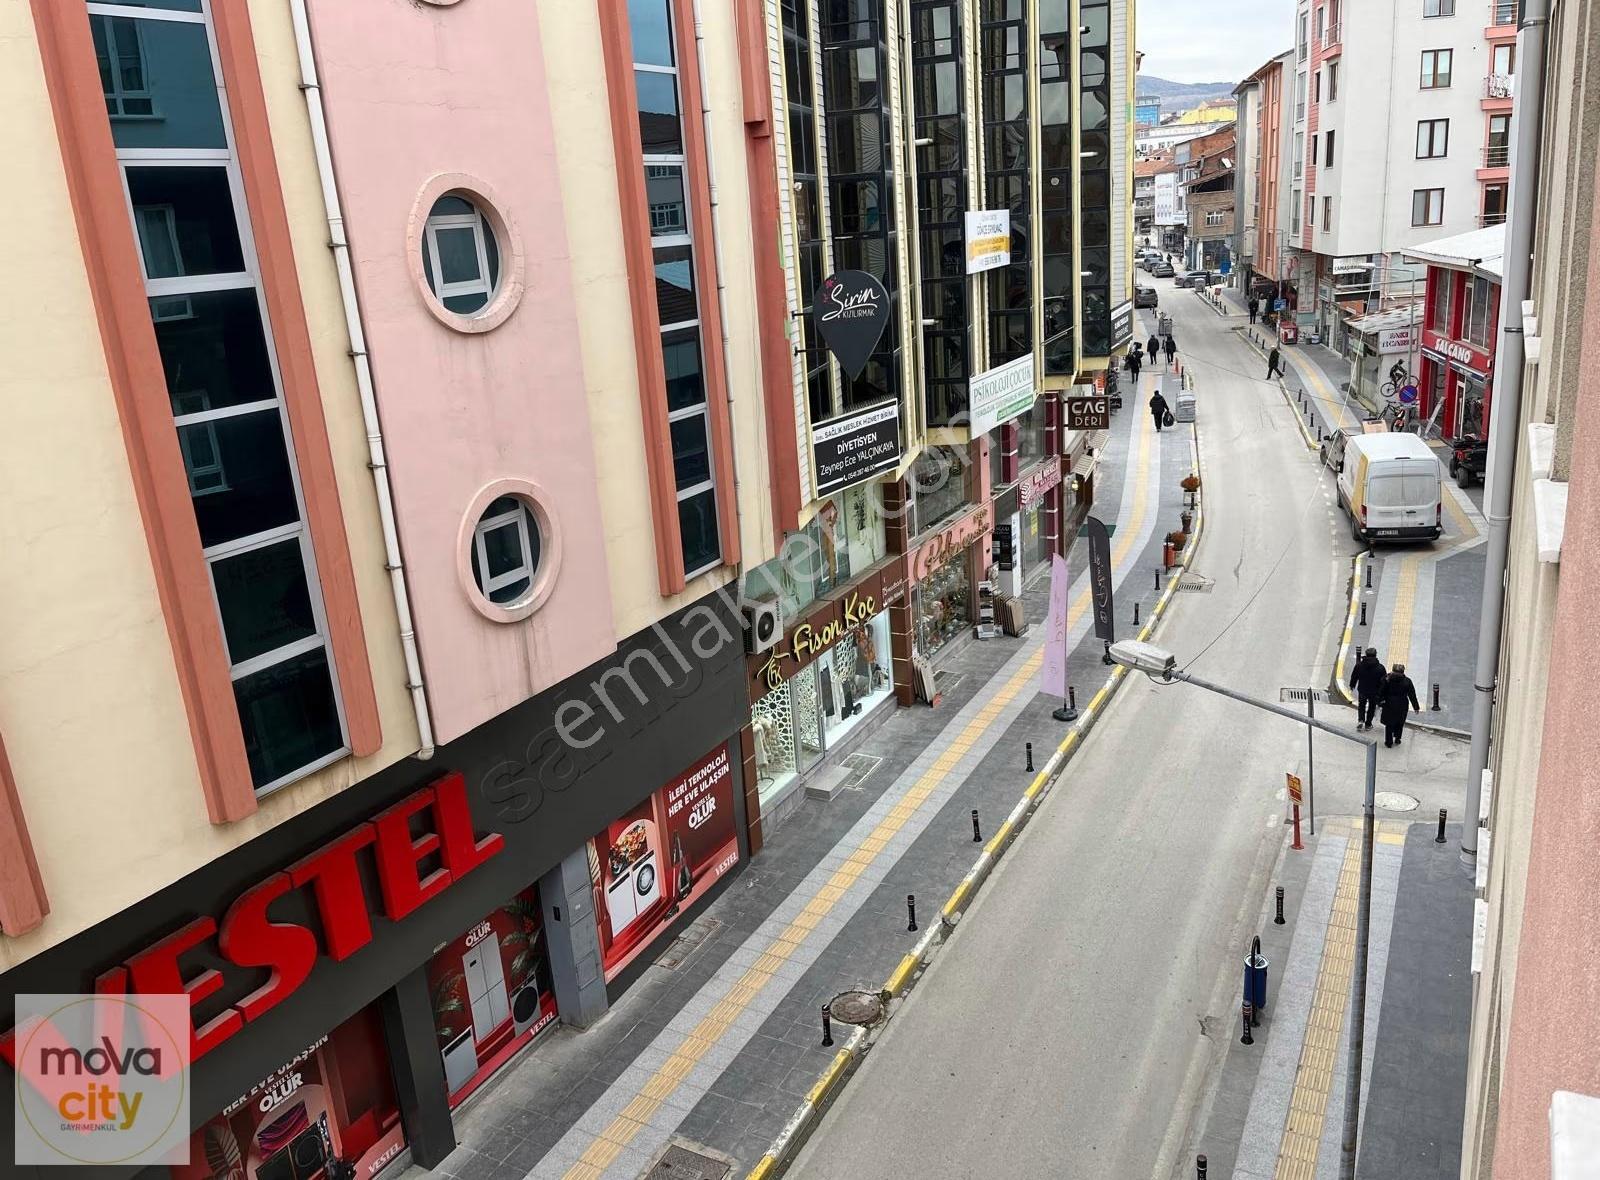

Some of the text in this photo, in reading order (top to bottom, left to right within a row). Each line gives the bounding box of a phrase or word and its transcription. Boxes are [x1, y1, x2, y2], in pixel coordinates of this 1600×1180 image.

[843, 308, 875, 319] KIZILIRMAK
[1434, 338, 1473, 364] SALCANO
[824, 426, 843, 439] SAĞLIK
[843, 420, 862, 432] MESLEK
[862, 413, 880, 425] HİZMET
[820, 440, 894, 476] Zeynep Ece YALÇINKAYA
[837, 431, 877, 455] DİYETİSYEN
[793, 619, 843, 662] Fison
[844, 592, 877, 630] Koç
[668, 749, 727, 803] İLERİ TEKNOLOJİ
[668, 763, 730, 818] HER EVE ULAŞSIN
[688, 796, 716, 828] OLUR
[714, 851, 738, 876] VESTEL
[465, 921, 491, 947] OLUR
[0, 770, 505, 1132] VESTEL
[530, 1010, 556, 1036] VESTEL
[259, 1072, 303, 1113] OLUR
[367, 1144, 402, 1174] VESTEL
